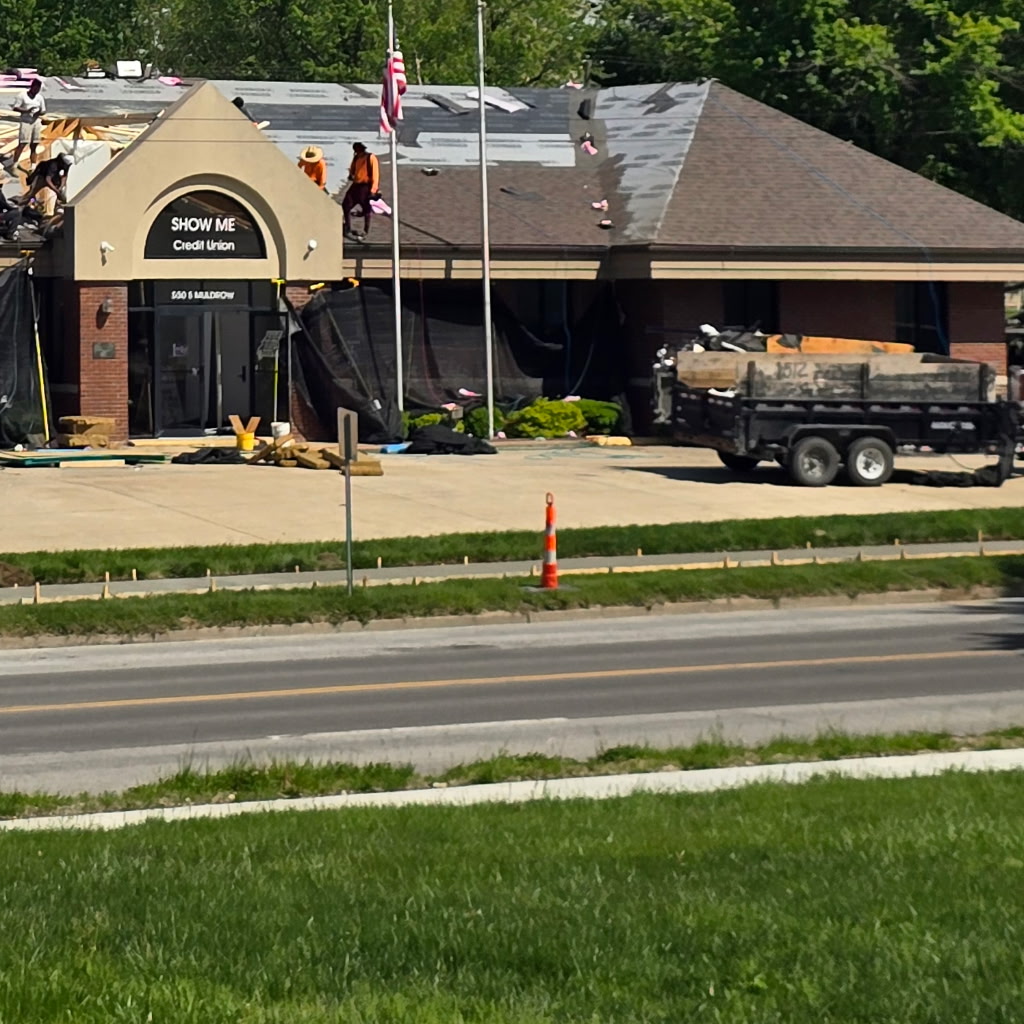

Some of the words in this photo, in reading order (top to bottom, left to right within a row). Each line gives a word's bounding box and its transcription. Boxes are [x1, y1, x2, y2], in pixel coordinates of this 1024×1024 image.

[171, 217, 212, 232] SHOW
[215, 218, 236, 232] ME
[173, 240, 204, 251] Credit
[206, 239, 235, 251] Union
